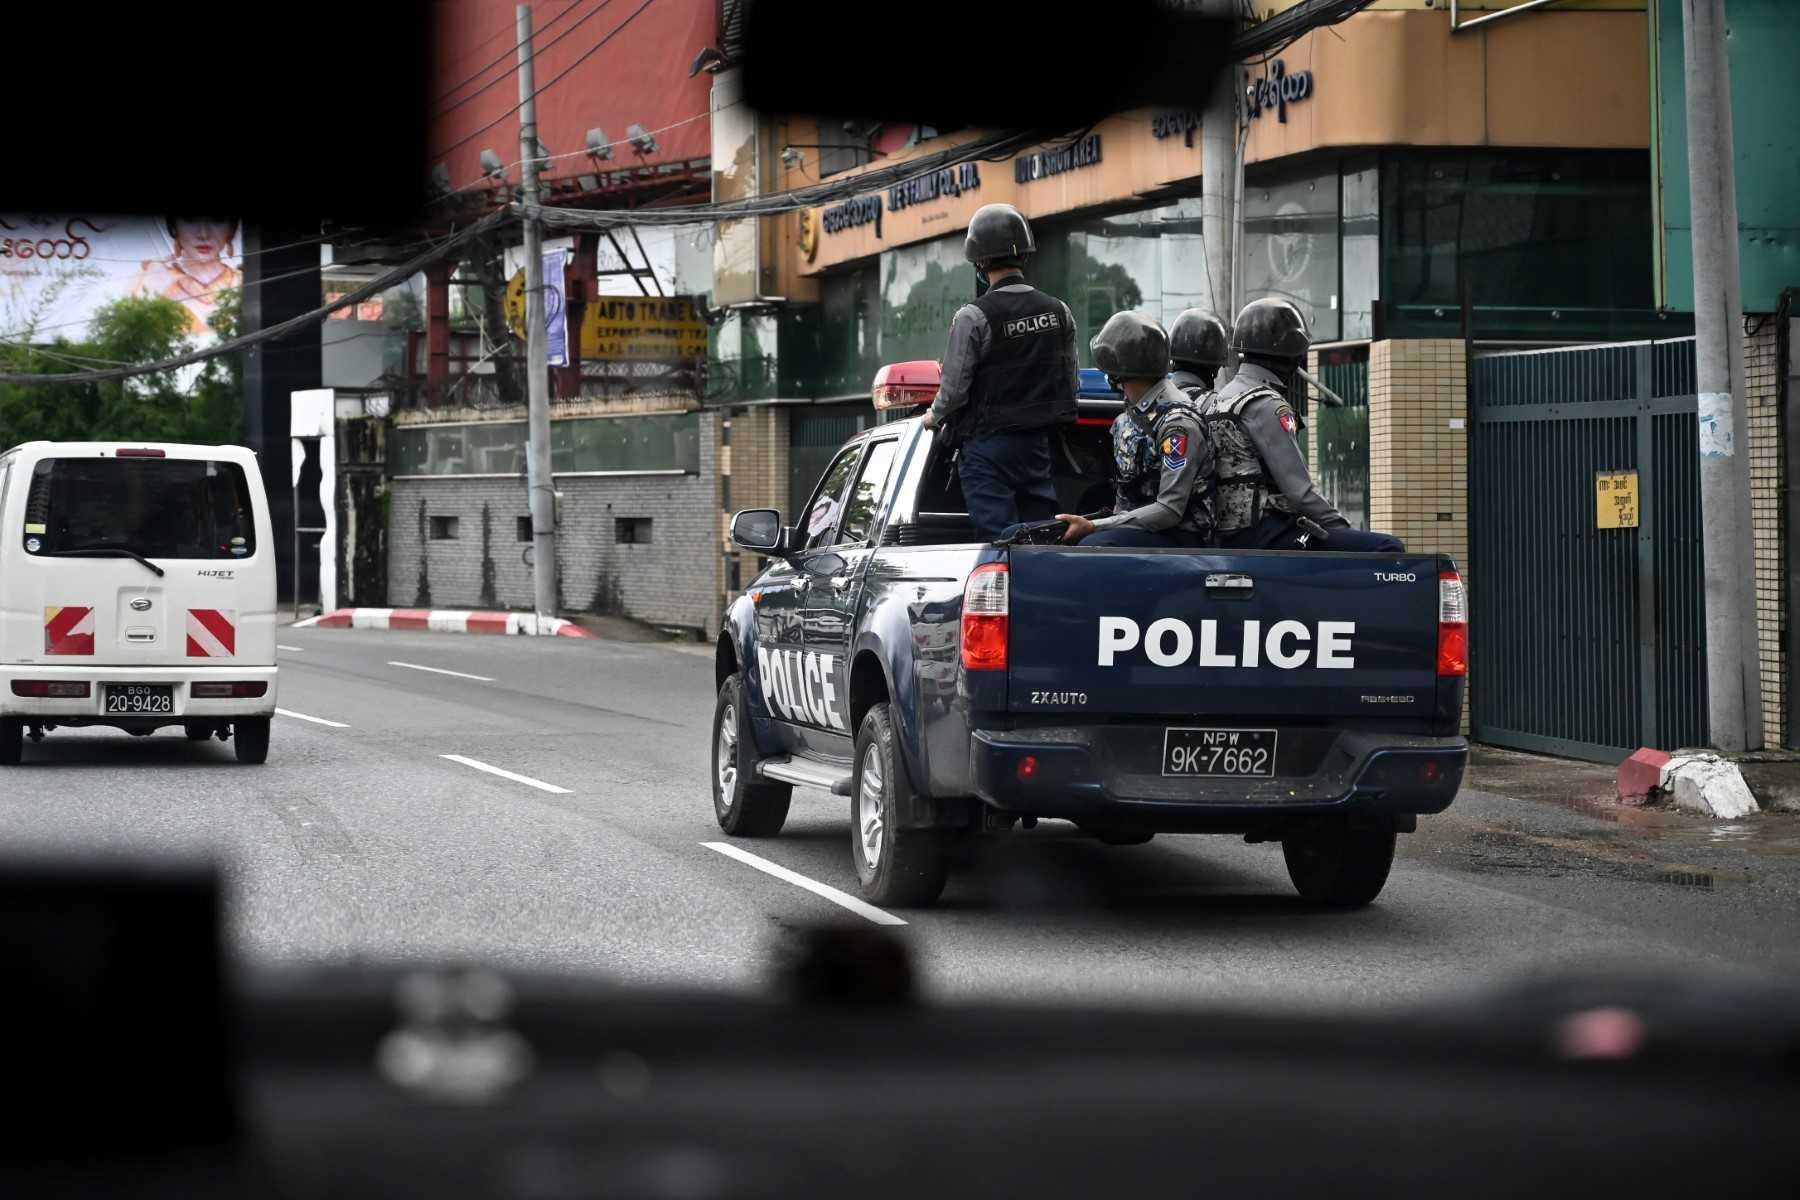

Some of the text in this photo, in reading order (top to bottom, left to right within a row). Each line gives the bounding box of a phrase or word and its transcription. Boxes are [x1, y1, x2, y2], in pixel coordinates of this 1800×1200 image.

[1073, 134, 1102, 168] AREA
[600, 301, 635, 320] AUTO
[1007, 314, 1058, 335] POLICE
[1374, 573, 1416, 582] TURBO
[1098, 616, 1355, 669] POLICE
[128, 687, 151, 695] BGO
[757, 646, 845, 729] POLICE
[109, 695, 171, 712] 2Q-9428
[1031, 691, 1088, 705] ZXAUTO
[1203, 731, 1240, 746] NPW
[1171, 746, 1268, 774] 9K-7662
